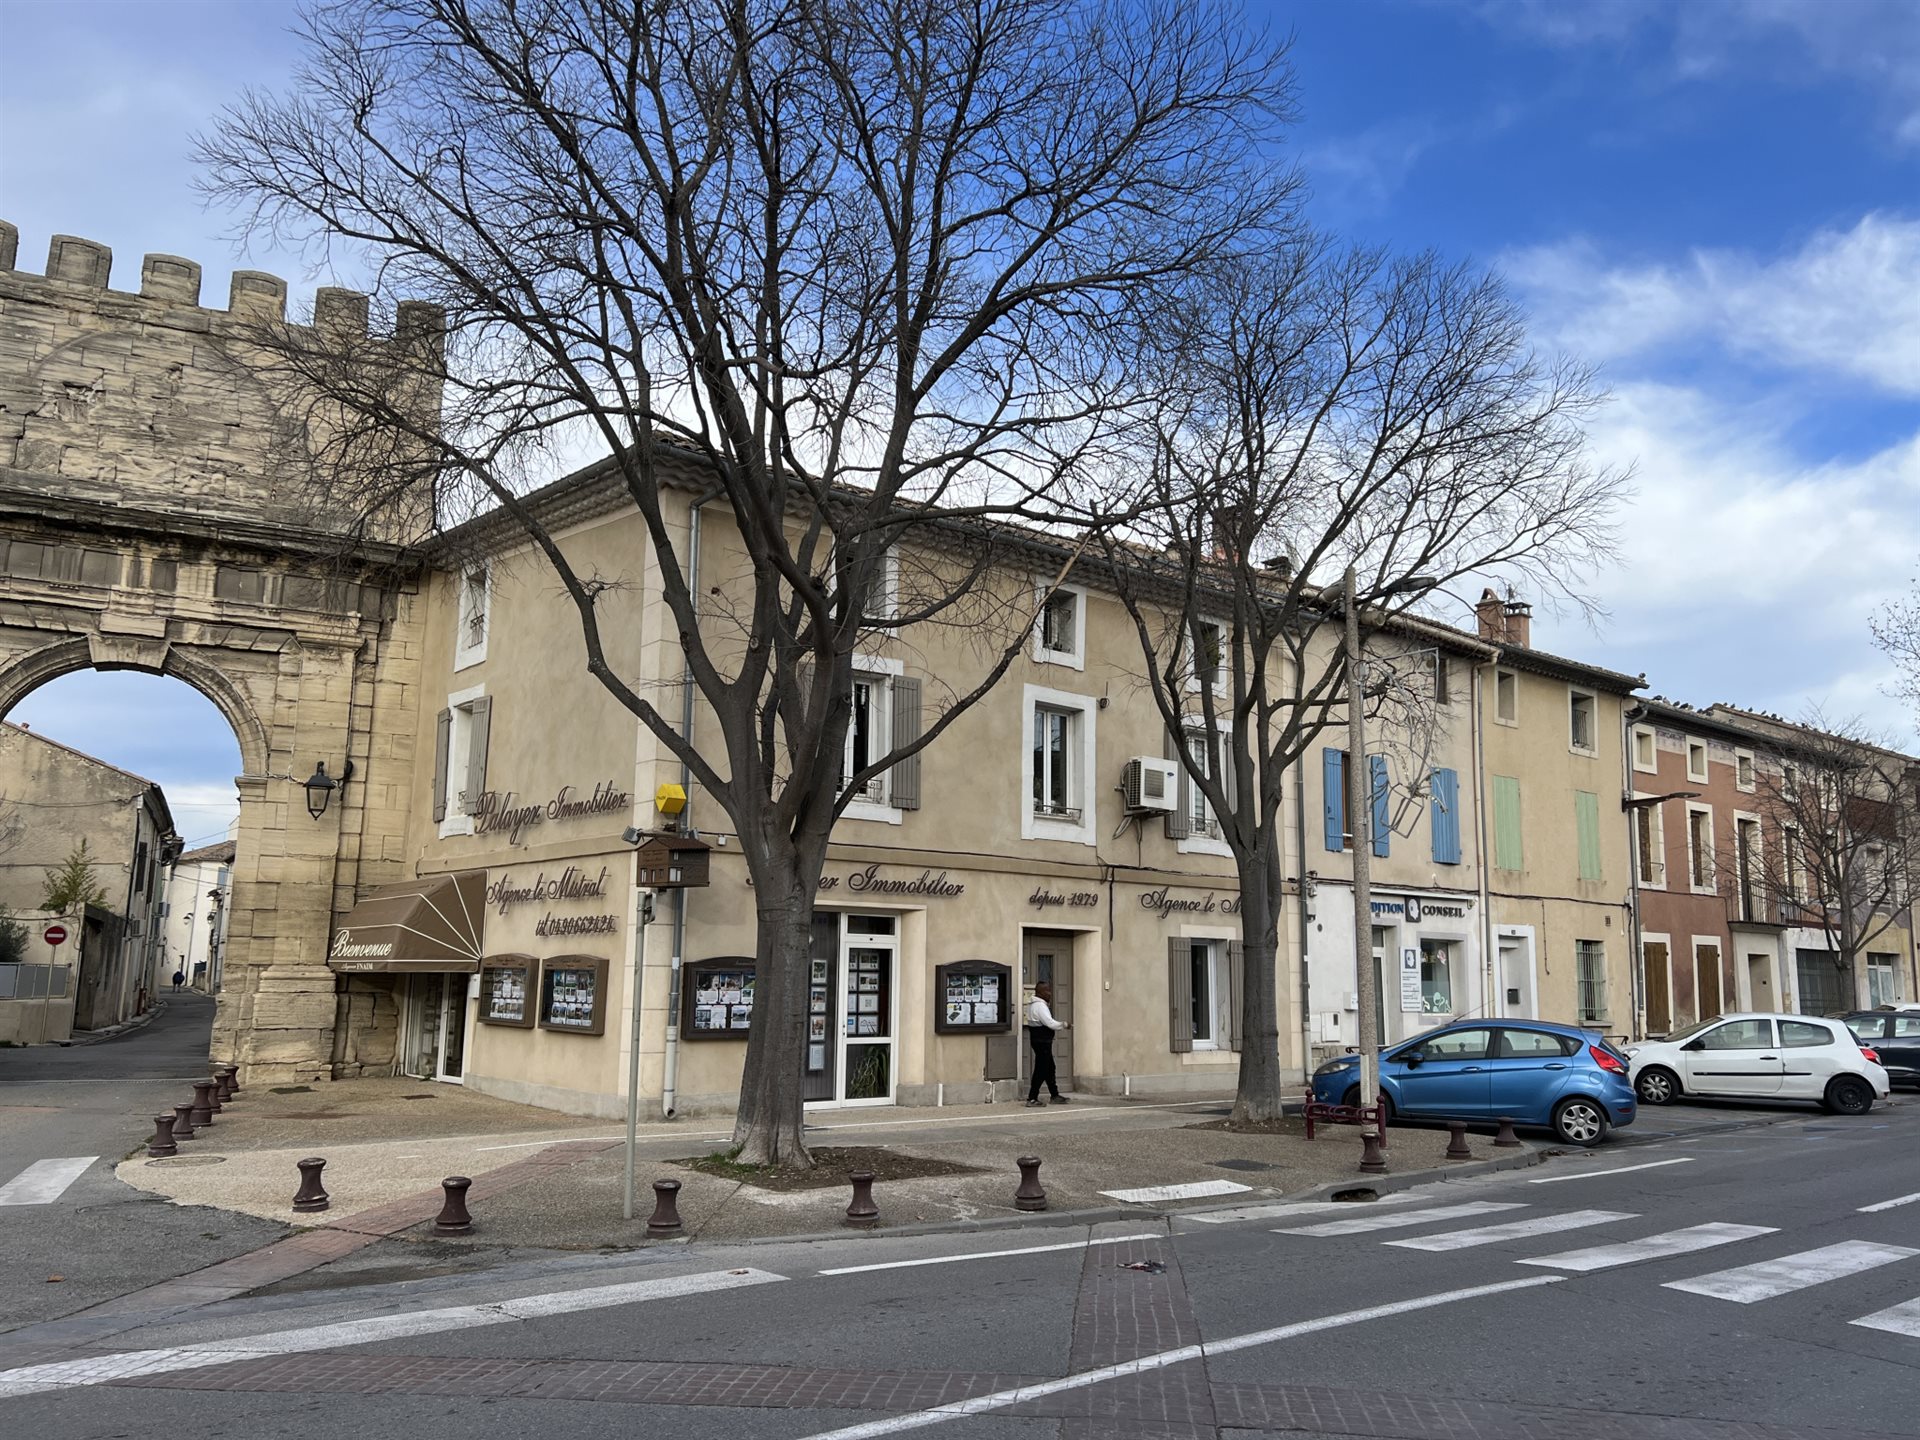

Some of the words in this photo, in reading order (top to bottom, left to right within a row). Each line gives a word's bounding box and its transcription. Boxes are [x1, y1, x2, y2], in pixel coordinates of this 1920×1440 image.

[474, 791, 541, 845] Palayer
[547, 780, 630, 820] Immobilier
[486, 874, 531, 916] Agence
[533, 873, 546, 901] le
[548, 866, 608, 900] Mistral
[849, 864, 964, 896] Immobilier
[1029, 886, 1065, 910] depuis
[1067, 892, 1098, 907] 1979
[1140, 886, 1200, 919] Agence
[1203, 891, 1216, 912] le
[1370, 901, 1404, 915] DITION
[1422, 905, 1465, 918] CONSEIL
[331, 930, 392, 957] Bienvenue
